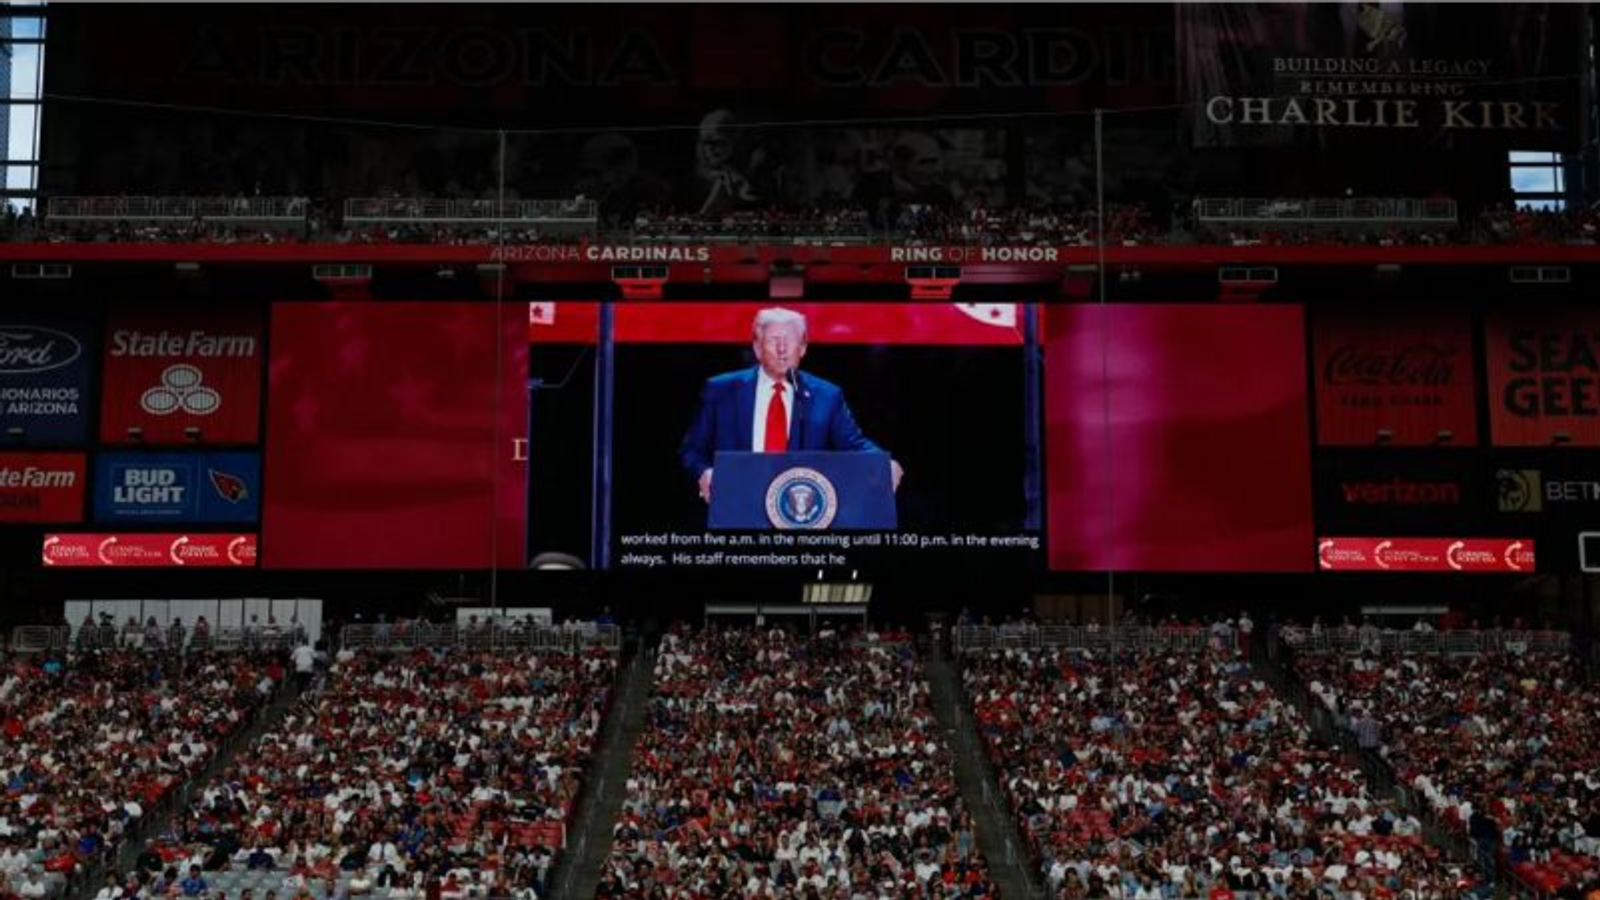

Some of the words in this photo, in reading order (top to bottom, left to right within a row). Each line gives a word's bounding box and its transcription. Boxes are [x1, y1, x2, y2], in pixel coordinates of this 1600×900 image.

[173, 25, 679, 87] ARIZONA
[1272, 57, 1380, 74] BUILDING
[1386, 59, 1401, 74] A
[1409, 58, 1494, 76] LEGACY
[1299, 79, 1466, 97] REMEMBERING
[1205, 96, 1420, 129] CHARLIE
[1441, 100, 1560, 130] KIRK
[490, 246, 580, 261] ARIZONA
[586, 246, 711, 261] CARDINALS
[891, 246, 943, 261] RING
[948, 246, 976, 261] OF
[982, 247, 1059, 261] HONOR
[0, 387, 80, 400] IONARIOS
[7, 402, 79, 415] ARIZONA
[124, 469, 176, 486] BUD
[113, 486, 185, 504] LIGHT
[1342, 477, 1460, 504] verizon
[621, 533, 667, 545] worked
[670, 533, 701, 545] from
[704, 533, 726, 545] five
[729, 535, 756, 545] a.m.
[759, 534, 771, 545] in
[773, 534, 793, 545] the
[797, 534, 850, 548] morning
[852, 534, 882, 545] until
[884, 534, 918, 545] 11:00
[920, 536, 949, 548] p.m.
[951, 534, 964, 545] in
[966, 534, 987, 545] the
[989, 534, 1040, 548] evening
[620, 552, 667, 567] always.
[672, 553, 692, 564] His
[695, 552, 724, 564] staff
[725, 552, 799, 564] remembers
[801, 553, 826, 564] that
[829, 553, 846, 564] he
